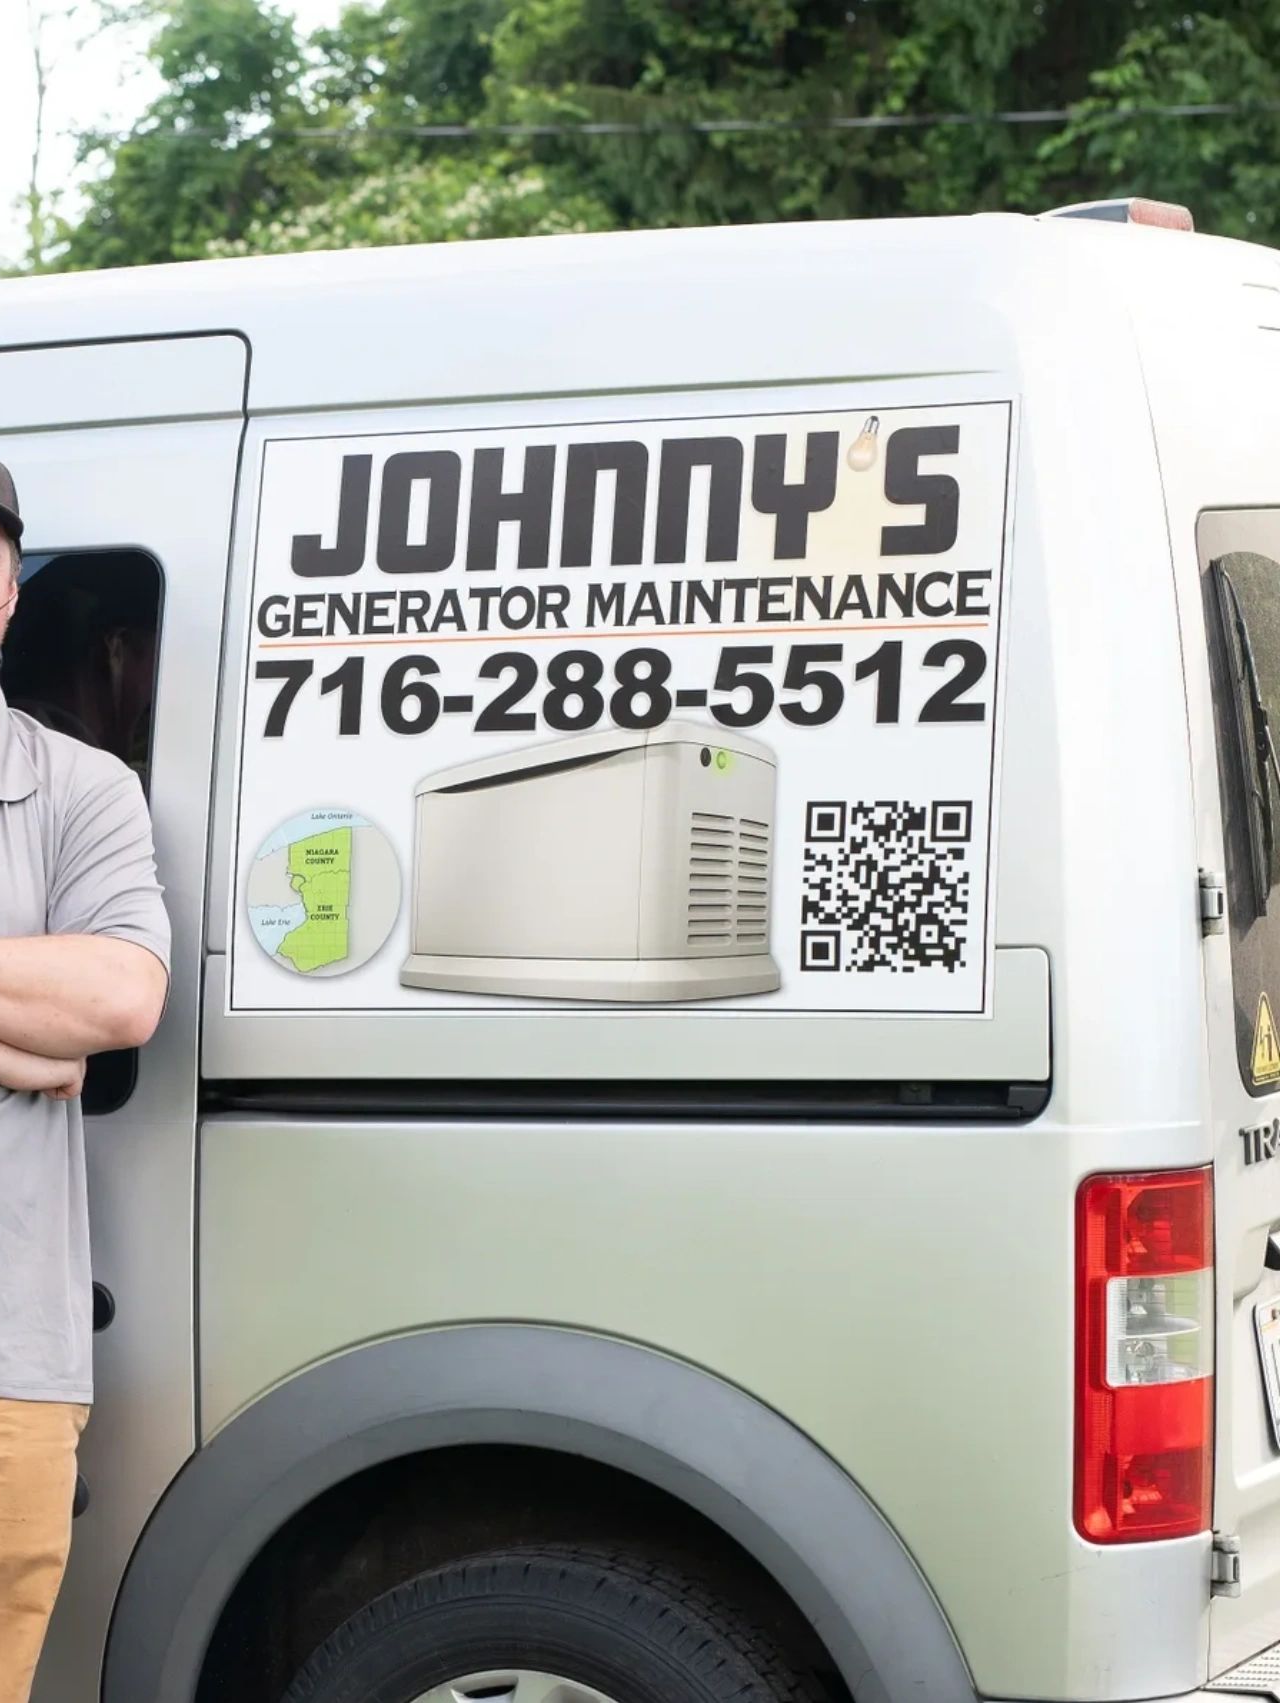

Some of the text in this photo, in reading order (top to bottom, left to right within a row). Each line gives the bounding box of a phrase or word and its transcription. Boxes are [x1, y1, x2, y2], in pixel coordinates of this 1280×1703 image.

[291, 416, 961, 578] JOHNNY'S
[257, 570, 992, 638] GENERATOR MAINTENANCE
[255, 639, 987, 737] 716-288-5512
[305, 848, 339, 856] NIAGARA
[305, 857, 335, 865] COUNTY
[310, 913, 340, 921] COUNTY
